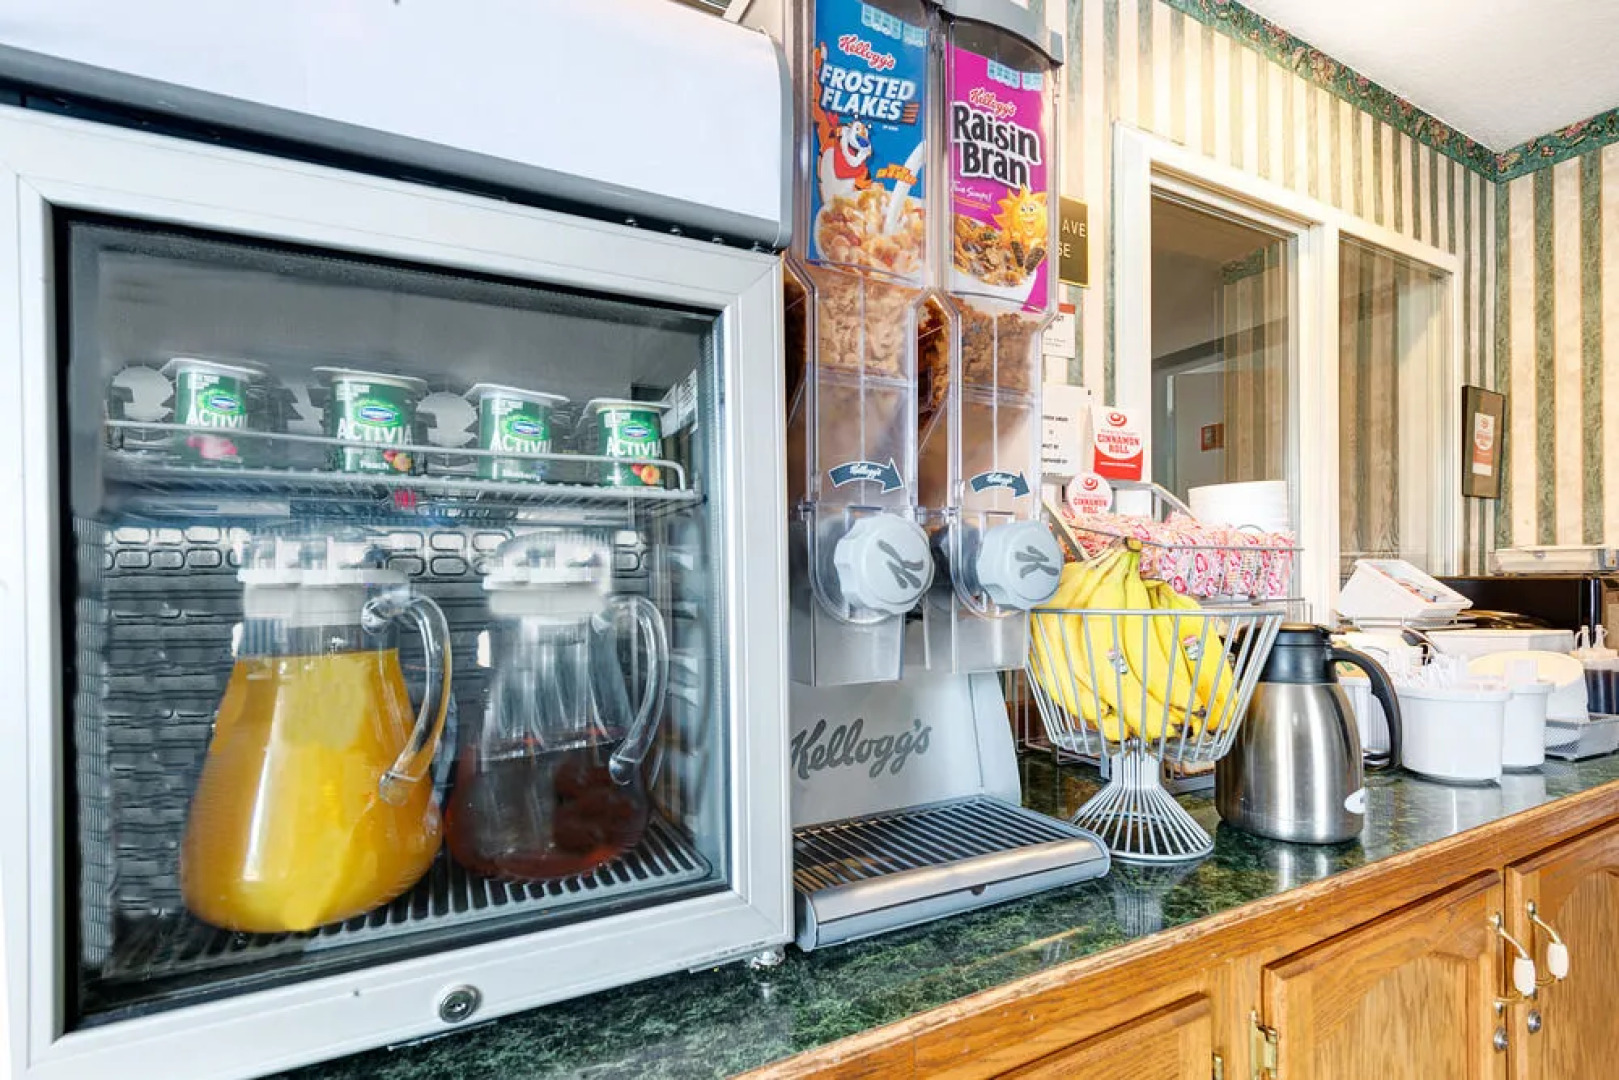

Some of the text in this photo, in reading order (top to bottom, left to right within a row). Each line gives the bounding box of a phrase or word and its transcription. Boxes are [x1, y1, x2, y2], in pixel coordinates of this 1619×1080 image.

[839, 35, 896, 71] Kellogg's
[820, 63, 916, 101] FROSTED
[821, 88, 903, 121] FLAKES
[969, 88, 1017, 118] Kellogg's
[952, 103, 1040, 163] Raisin
[962, 141, 1028, 190] Bran
[790, 718, 932, 779] Kellogg's
